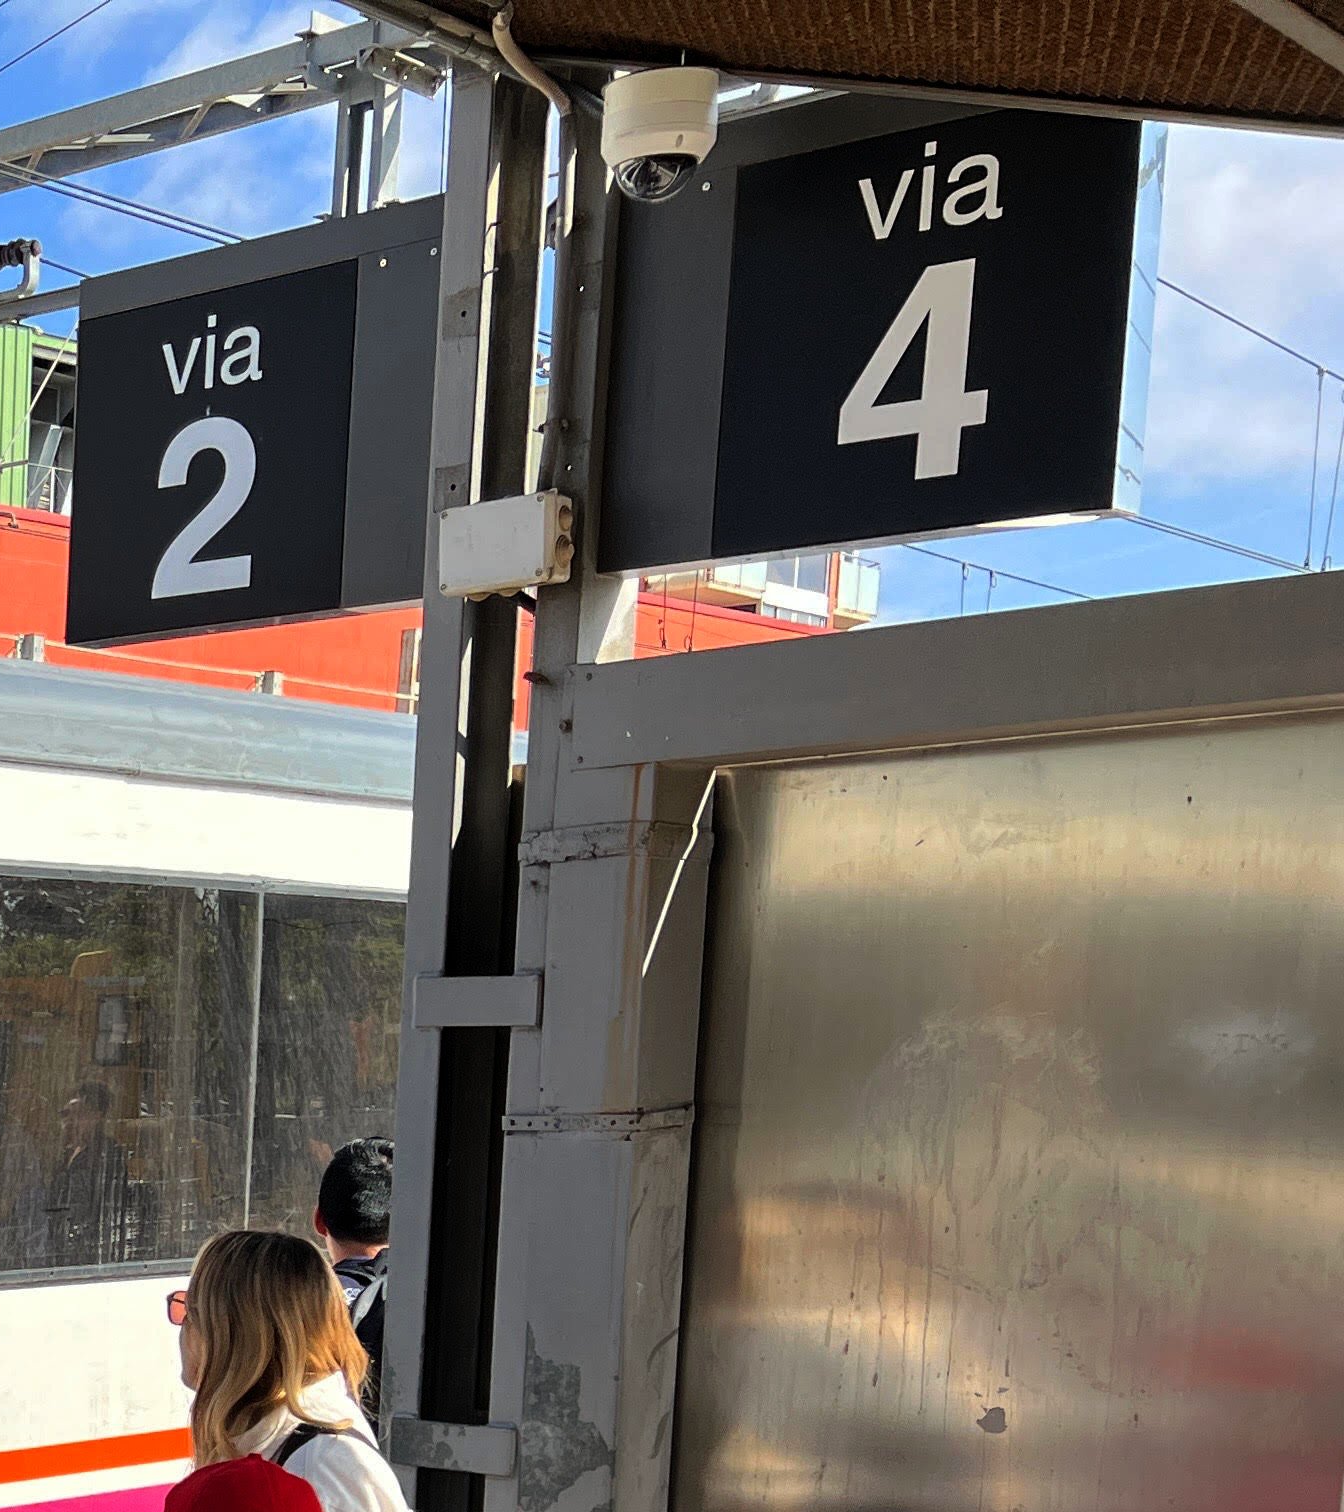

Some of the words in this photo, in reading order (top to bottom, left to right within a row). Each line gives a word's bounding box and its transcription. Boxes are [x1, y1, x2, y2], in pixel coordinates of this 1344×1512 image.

[858, 140, 1004, 240] via
[162, 314, 263, 395] via
[837, 257, 989, 480] 4
[150, 416, 257, 600] 2
